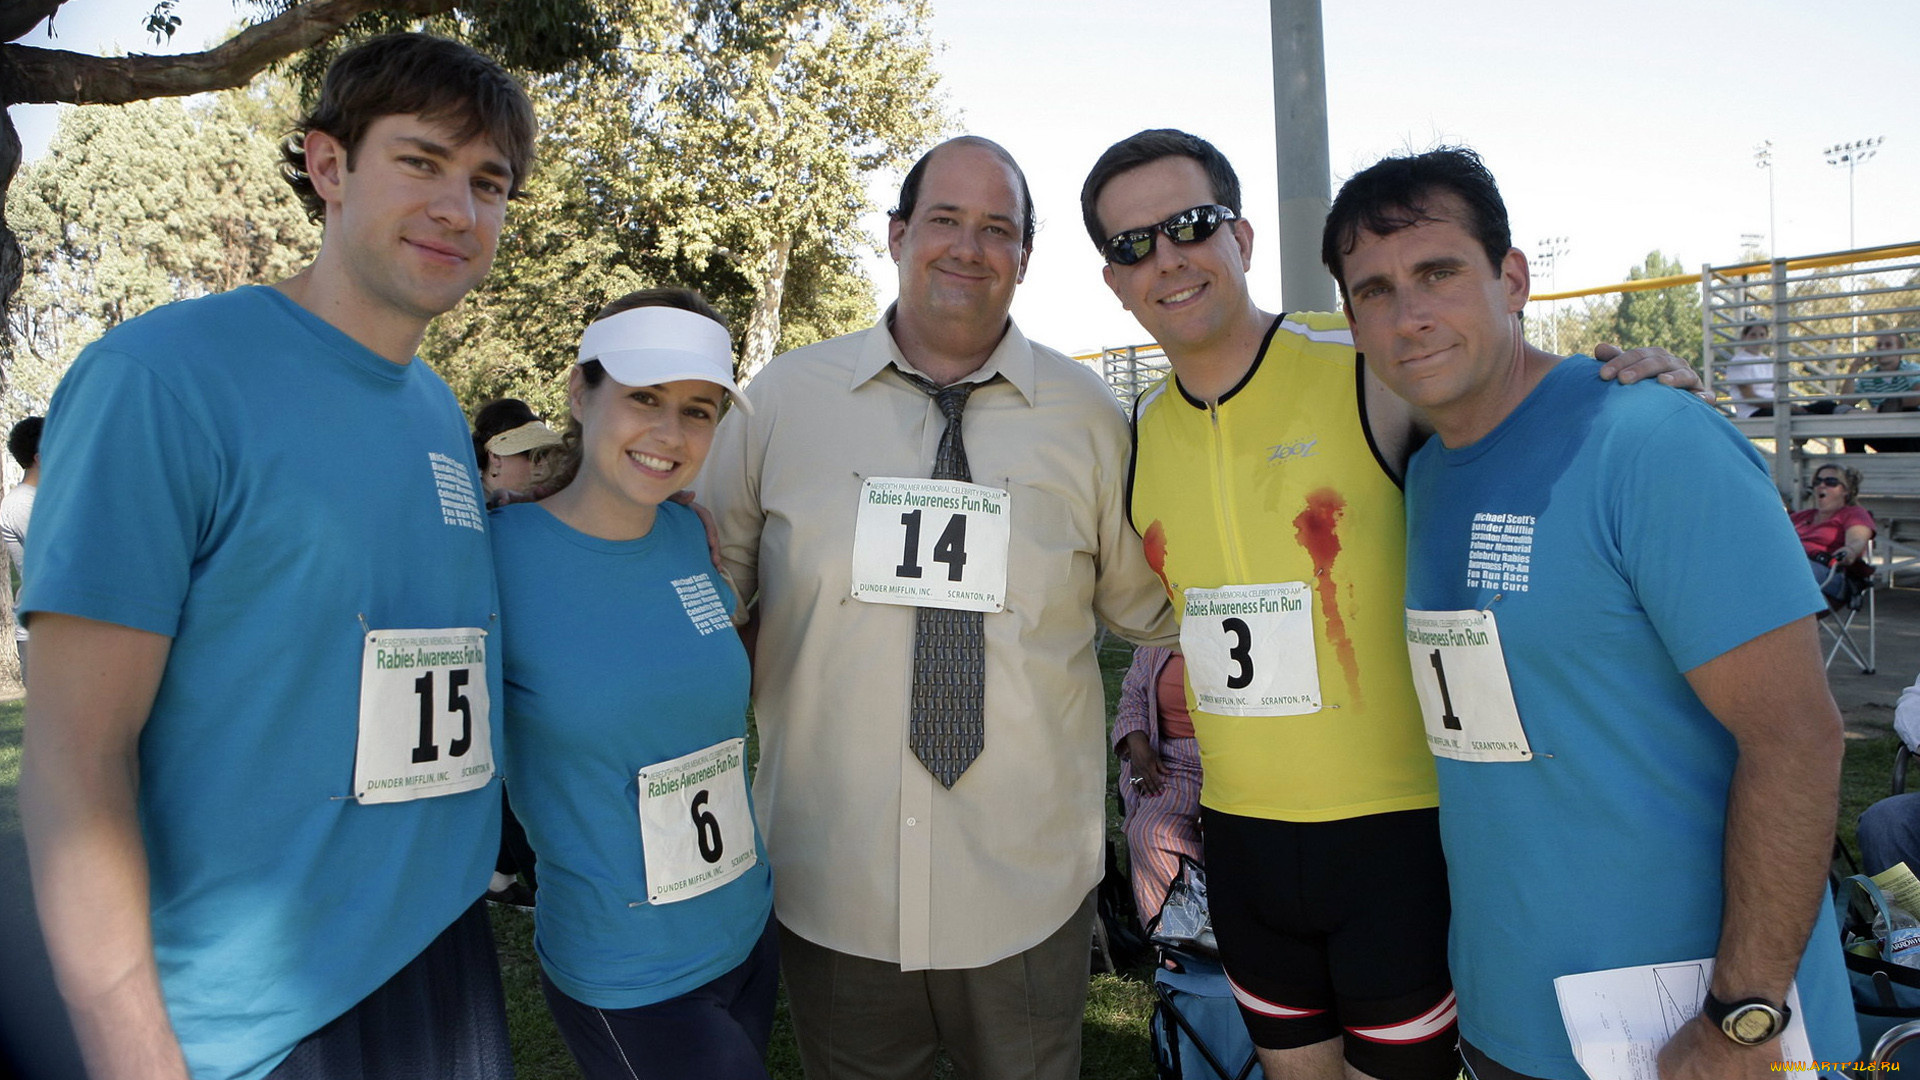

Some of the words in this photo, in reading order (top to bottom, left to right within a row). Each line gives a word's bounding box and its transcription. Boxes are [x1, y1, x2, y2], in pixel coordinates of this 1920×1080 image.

[899, 483, 920, 491] PALMER
[921, 485, 951, 494] MEMORIAL
[951, 487, 980, 496] CELEBRITY
[869, 490, 903, 505] Rabies
[904, 491, 960, 510] Awareness
[961, 495, 981, 512] Fun
[982, 498, 1001, 515] Run
[1506, 514, 1536, 525] Scott's
[1504, 525, 1534, 535] Mifflin
[1471, 532, 1500, 542] Scranton
[1500, 534, 1533, 544] Meredith
[896, 509, 967, 582] 14
[1470, 541, 1494, 550] Palmer
[1495, 543, 1532, 553] Memorial
[1469, 550, 1501, 562] Celebrity
[1502, 553, 1530, 563] Rabies
[1502, 562, 1529, 573] Pro-Am
[1467, 569, 1480, 578] Fun
[1482, 570, 1500, 580] Run
[1503, 572, 1529, 583] Race
[859, 583, 888, 593] DUNDER
[888, 585, 918, 596] MIFFLIN,
[918, 587, 933, 597] INC.
[1248, 588, 1277, 598] CELEBRITY
[1277, 587, 1301, 596] PRO-AM
[1467, 579, 1479, 587] For
[1481, 580, 1499, 590] The
[1502, 581, 1529, 592] Cure
[947, 590, 986, 602] SCRANTON,
[986, 594, 996, 603] PA
[1185, 601, 1208, 617] Rabies
[1209, 600, 1258, 616] Awareness
[1259, 598, 1279, 613] Fun
[1281, 596, 1302, 612] Run
[1448, 629, 1467, 646] Fun
[1465, 628, 1489, 646] Run
[377, 648, 414, 669] Rabies
[416, 648, 463, 667] Awareness
[464, 645, 475, 664] Fun
[1222, 617, 1254, 689] 3
[1430, 649, 1462, 730] 1
[1236, 697, 1248, 706] INC.
[1261, 696, 1300, 706] SCRANTON,
[412, 669, 472, 764] 15
[1472, 741, 1509, 750] SCRANTON,
[1509, 742, 1519, 750] PA
[367, 778, 405, 790] DUNDER
[405, 774, 436, 786] MIFFLIN,
[436, 771, 450, 781] INC.
[648, 776, 680, 798] Rabies
[680, 764, 717, 789] Awareness
[716, 759, 727, 774] Fun
[727, 754, 740, 770] Run
[691, 789, 723, 863] 6
[657, 879, 687, 894] DUNDER
[687, 871, 713, 886] MIFFLIN,
